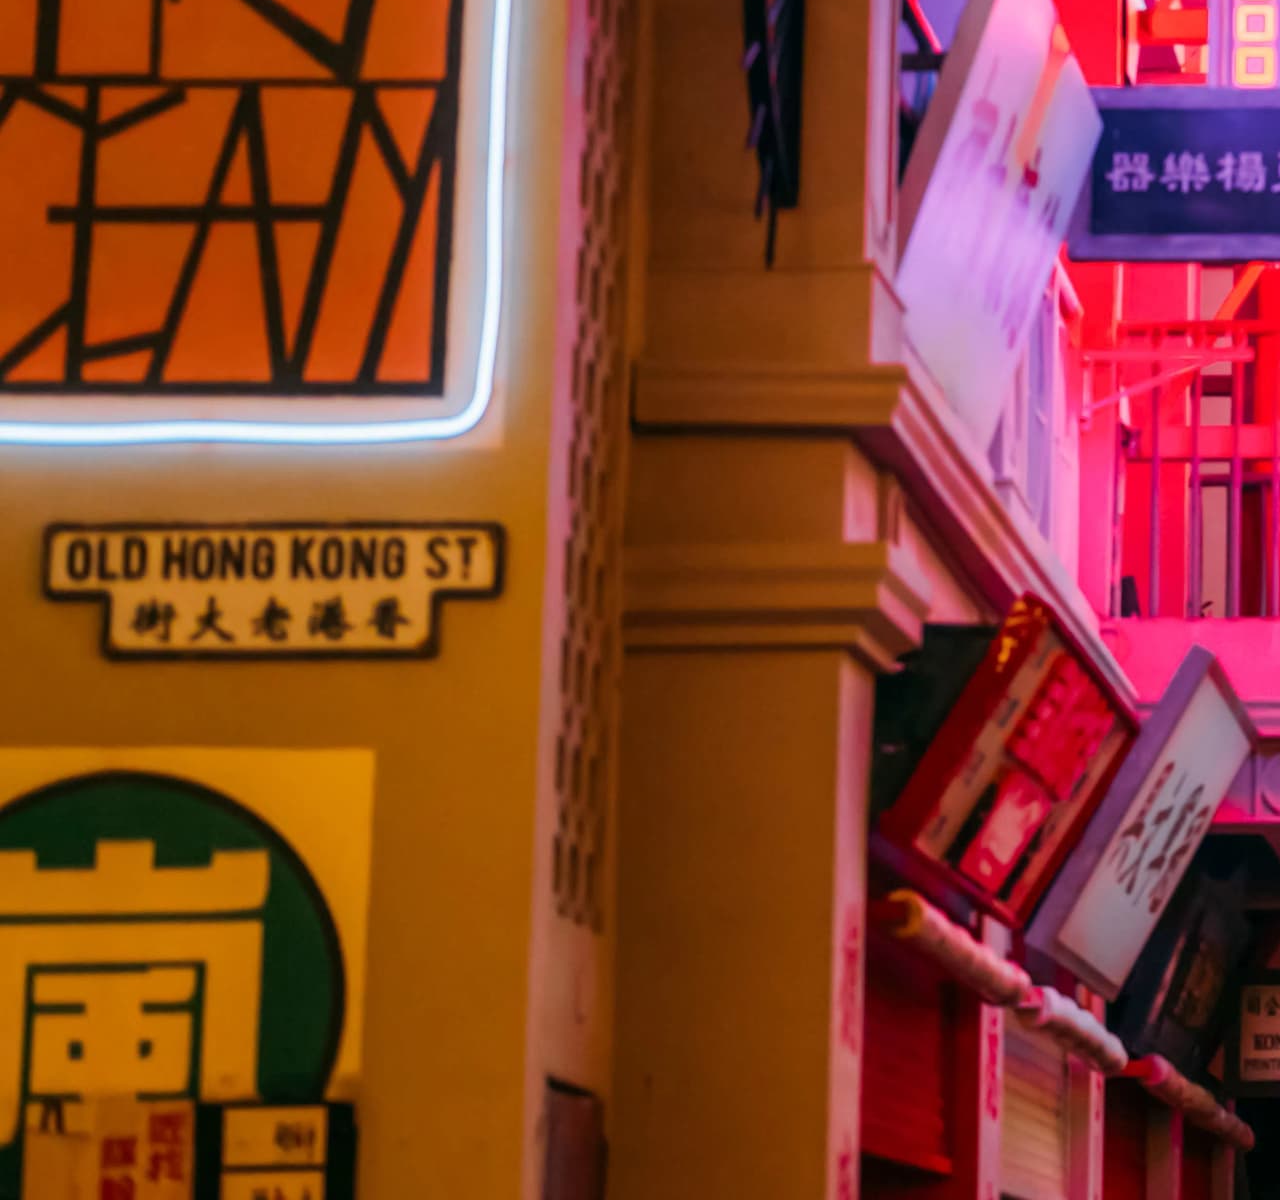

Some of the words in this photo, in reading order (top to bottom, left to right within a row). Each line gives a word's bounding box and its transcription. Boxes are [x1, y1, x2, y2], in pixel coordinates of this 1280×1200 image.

[66, 537, 147, 581] OLD
[162, 538, 276, 581] HONG
[290, 538, 406, 581] KONG
[425, 537, 478, 580] ST
